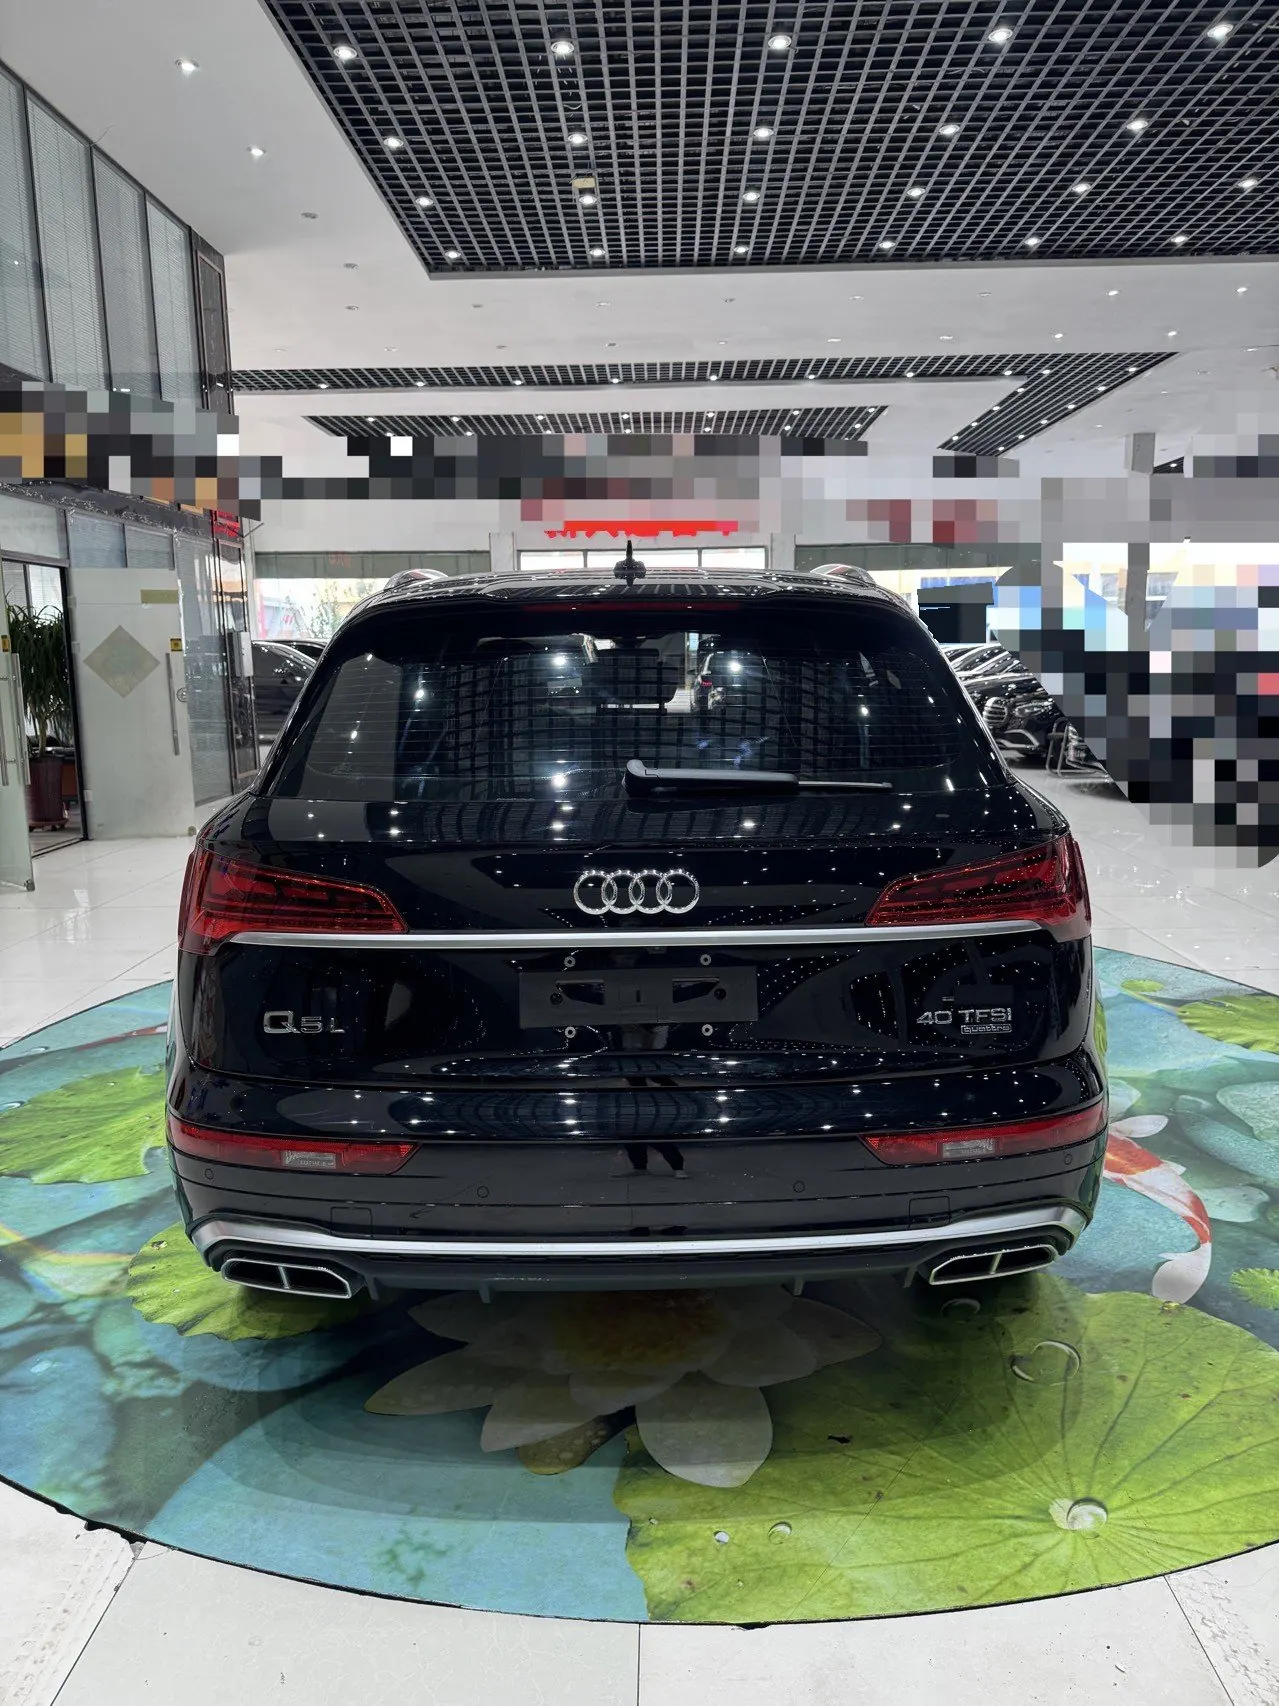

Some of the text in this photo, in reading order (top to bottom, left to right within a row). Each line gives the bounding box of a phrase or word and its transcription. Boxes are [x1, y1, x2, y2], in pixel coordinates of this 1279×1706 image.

[916, 1007, 1012, 1025] 40 TFSI
[961, 1024, 1012, 1034] quattro
